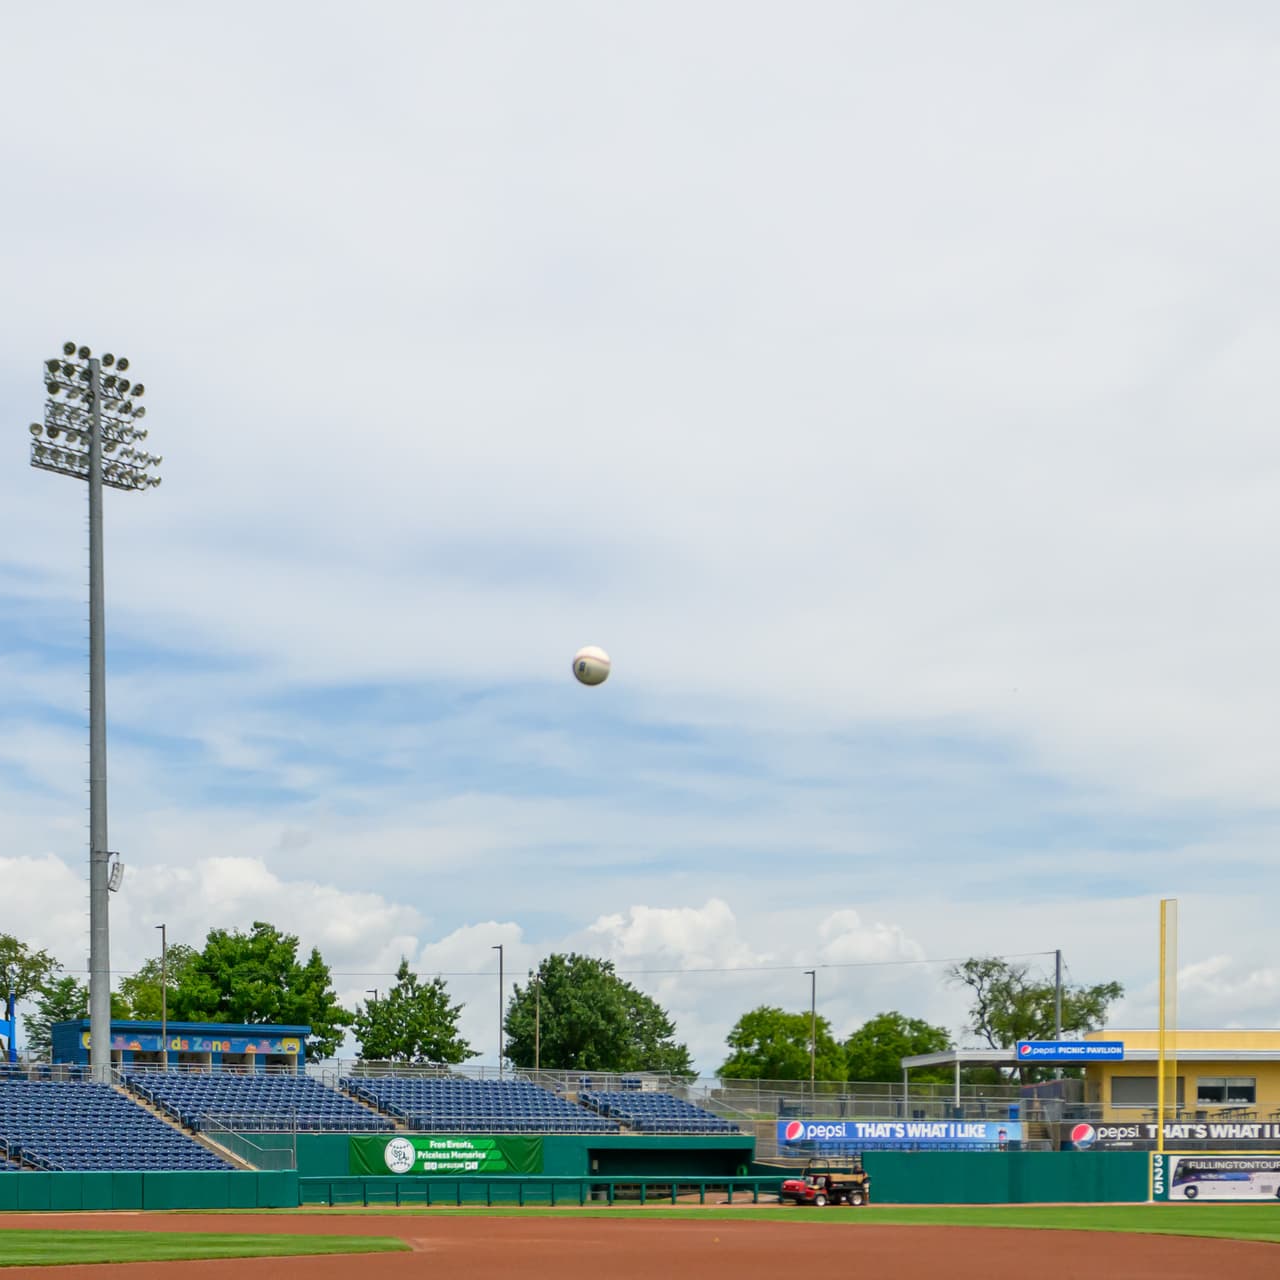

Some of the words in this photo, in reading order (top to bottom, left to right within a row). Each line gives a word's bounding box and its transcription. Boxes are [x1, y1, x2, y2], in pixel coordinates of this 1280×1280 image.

[193, 1036, 231, 1052] Zone
[1033, 1046, 1056, 1055] pepsi
[1058, 1046, 1085, 1054] PICNIC
[1086, 1046, 1122, 1054] PAVILION
[807, 1122, 847, 1140] pepsi
[855, 1123, 904, 1138] THAT'S
[907, 1123, 950, 1138] WHAT
[957, 1123, 986, 1138] LIKE
[1096, 1125, 1140, 1141] pepsi
[1146, 1125, 1207, 1138] THAT'S
[1209, 1125, 1263, 1138] WHAT
[430, 1141, 447, 1149] Free
[447, 1141, 474, 1149] Events,
[417, 1151, 450, 1159] Priceless
[451, 1151, 486, 1159] Memories
